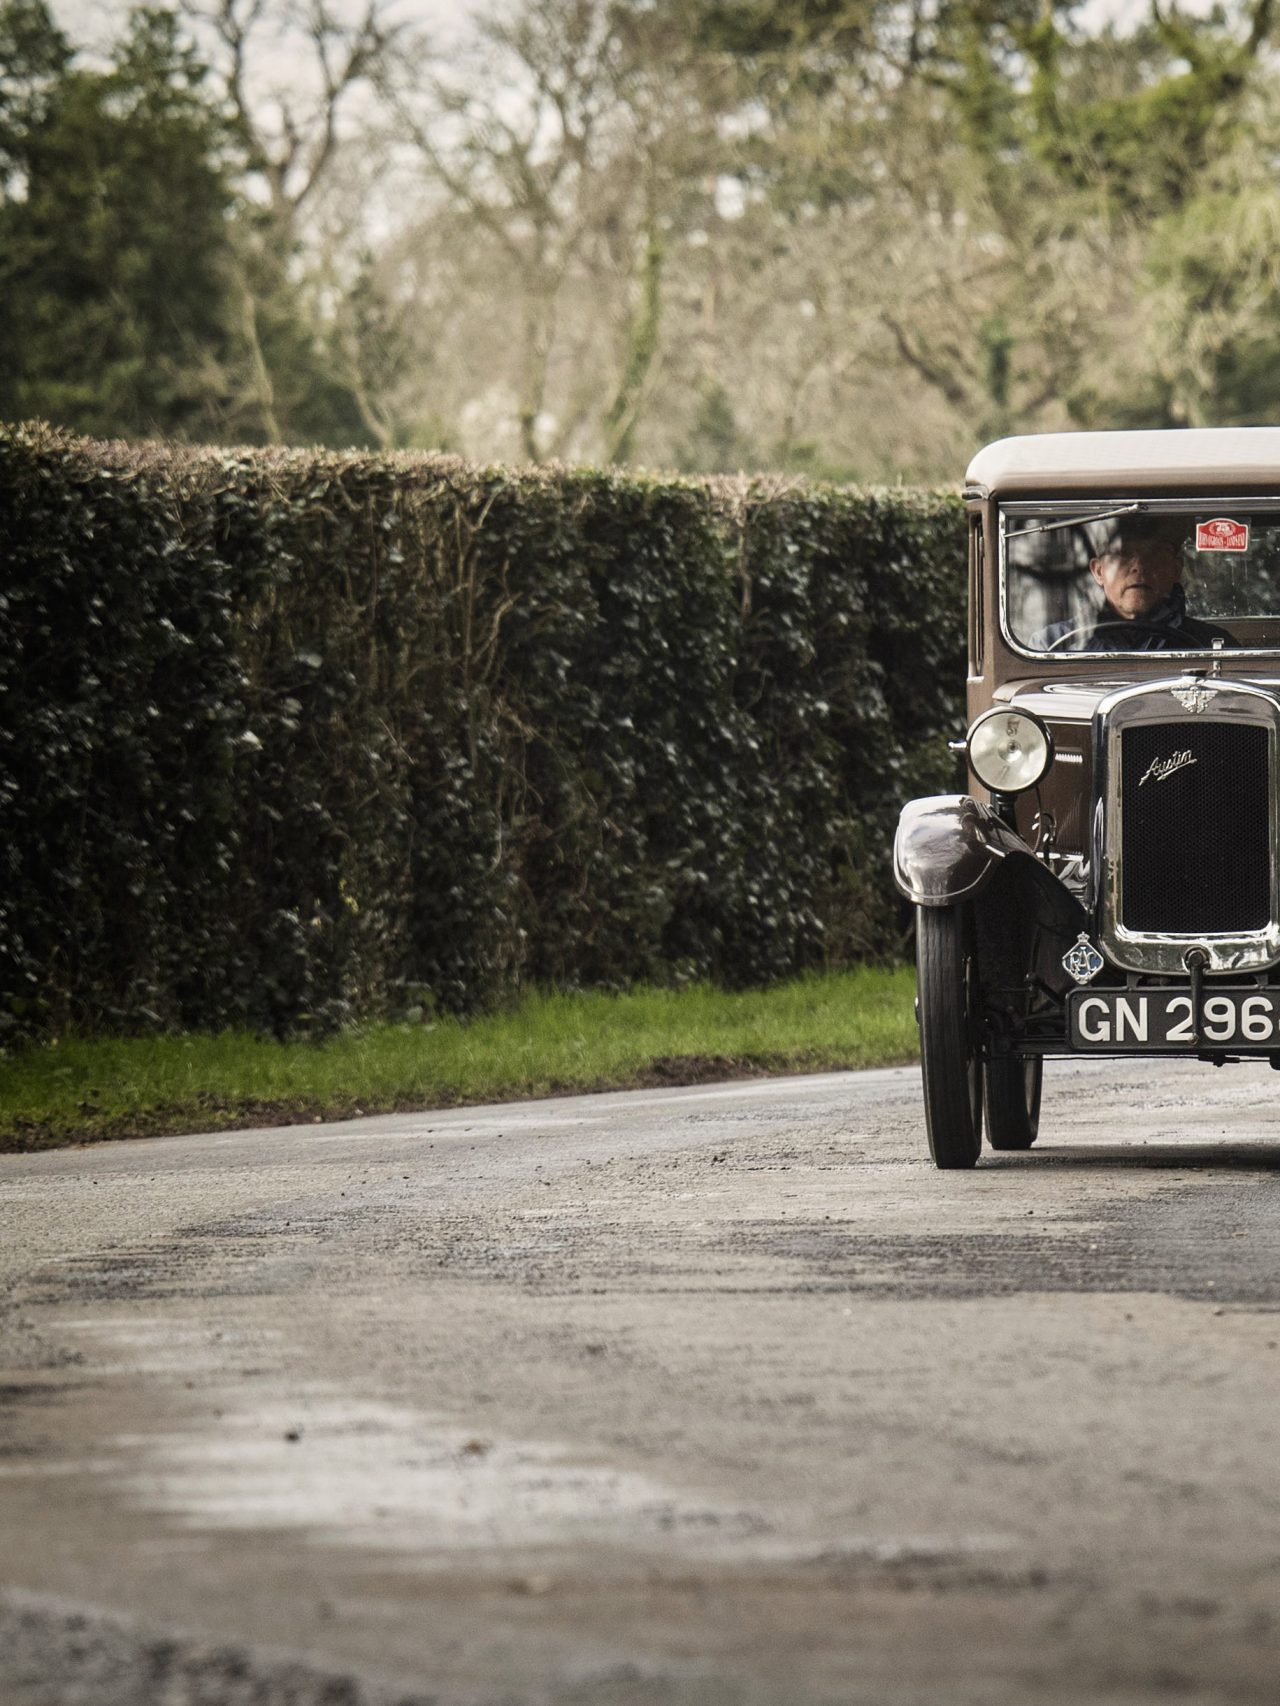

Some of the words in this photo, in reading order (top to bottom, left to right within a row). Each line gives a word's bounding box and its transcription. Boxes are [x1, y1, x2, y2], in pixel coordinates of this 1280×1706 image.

[1139, 750, 1197, 786] Austin
[1070, 946, 1098, 972] RAC
[1078, 997, 1148, 1042] GN
